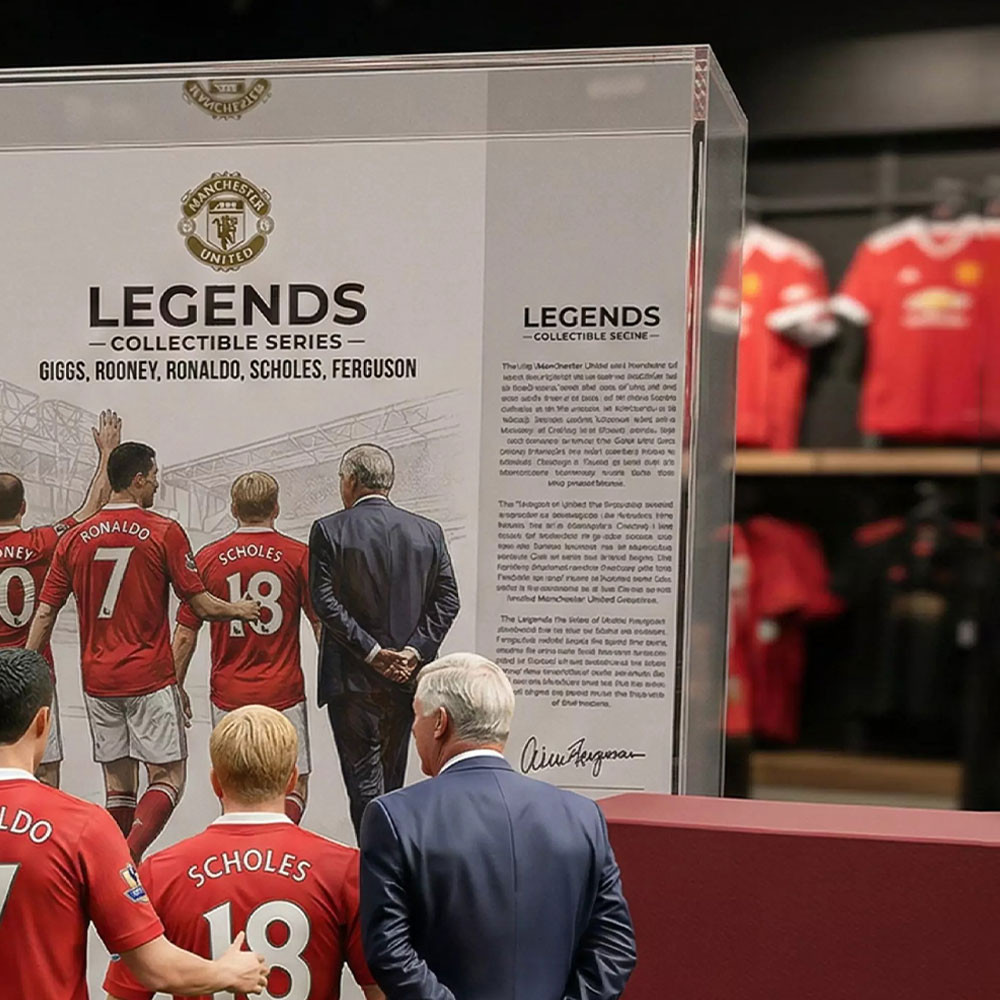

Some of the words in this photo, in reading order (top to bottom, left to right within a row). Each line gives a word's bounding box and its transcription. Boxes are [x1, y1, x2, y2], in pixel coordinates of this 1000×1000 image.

[188, 180, 265, 213] MANCHESTER
[200, 247, 253, 265] UNITED
[89, 282, 367, 327] LEGENDS
[523, 306, 661, 328] LEGENDS
[111, 336, 258, 351] COLLECTIBLE
[265, 334, 342, 350] SERIES
[533, 332, 606, 341] COLLECTIBLE
[39, 360, 90, 383] GIGGS,
[95, 359, 161, 383] ROONEY,
[166, 359, 245, 382] RONALDO,
[250, 358, 327, 381] SCHOLES,
[332, 358, 417, 379] FERGUSON
[79, 520, 150, 544] RONALDO
[218, 544, 283, 566] SCHOLES
[94, 546, 135, 619] 7
[226, 570, 283, 637] 18
[187, 848, 313, 887] SCHOLES
